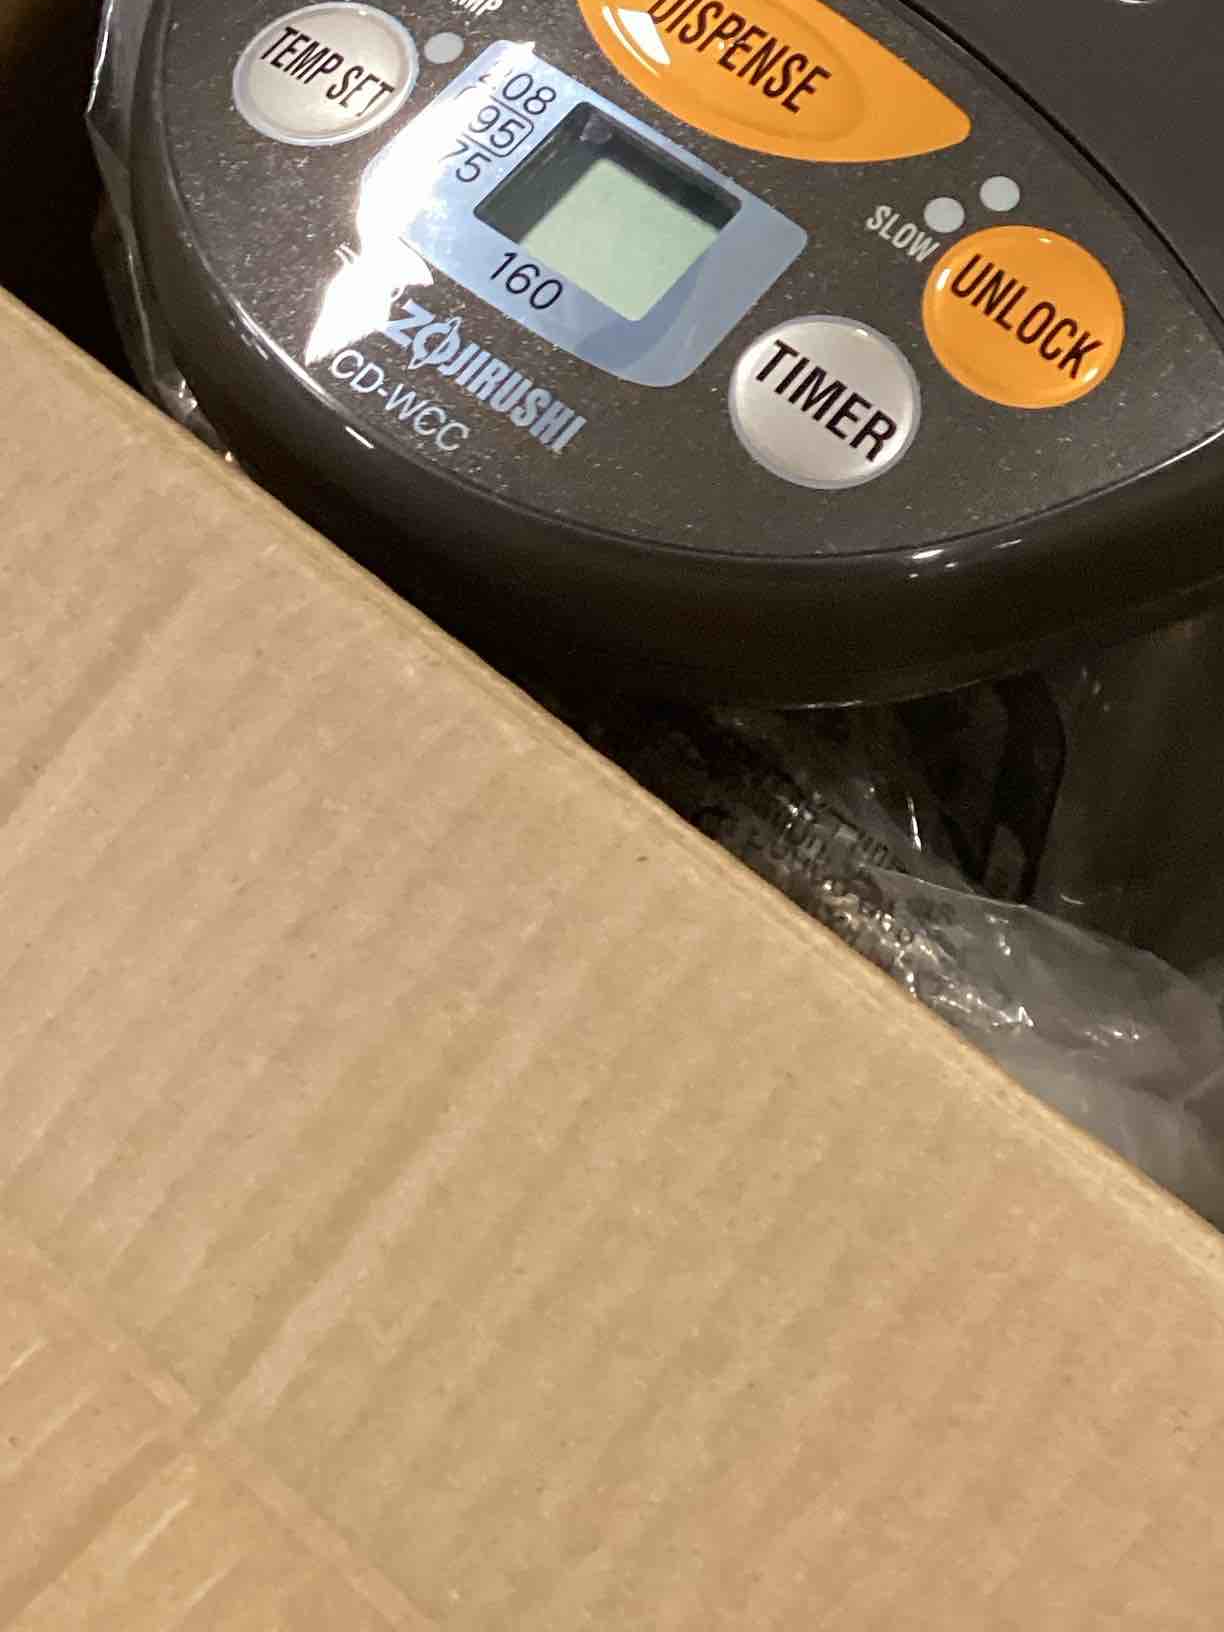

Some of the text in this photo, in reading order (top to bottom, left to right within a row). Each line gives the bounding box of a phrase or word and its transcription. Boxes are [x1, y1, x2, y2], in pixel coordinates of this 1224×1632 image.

[260, 26, 395, 117] TEMP SET
[488, 70, 557, 115] 08
[490, 252, 564, 310] 160
[865, 204, 940, 264] SLOW
[951, 253, 1104, 379] UNLOCK
[328, 349, 469, 451] CD-WCC
[383, 298, 587, 451] ZOJIRUSHI
[755, 338, 897, 462] TIMER
